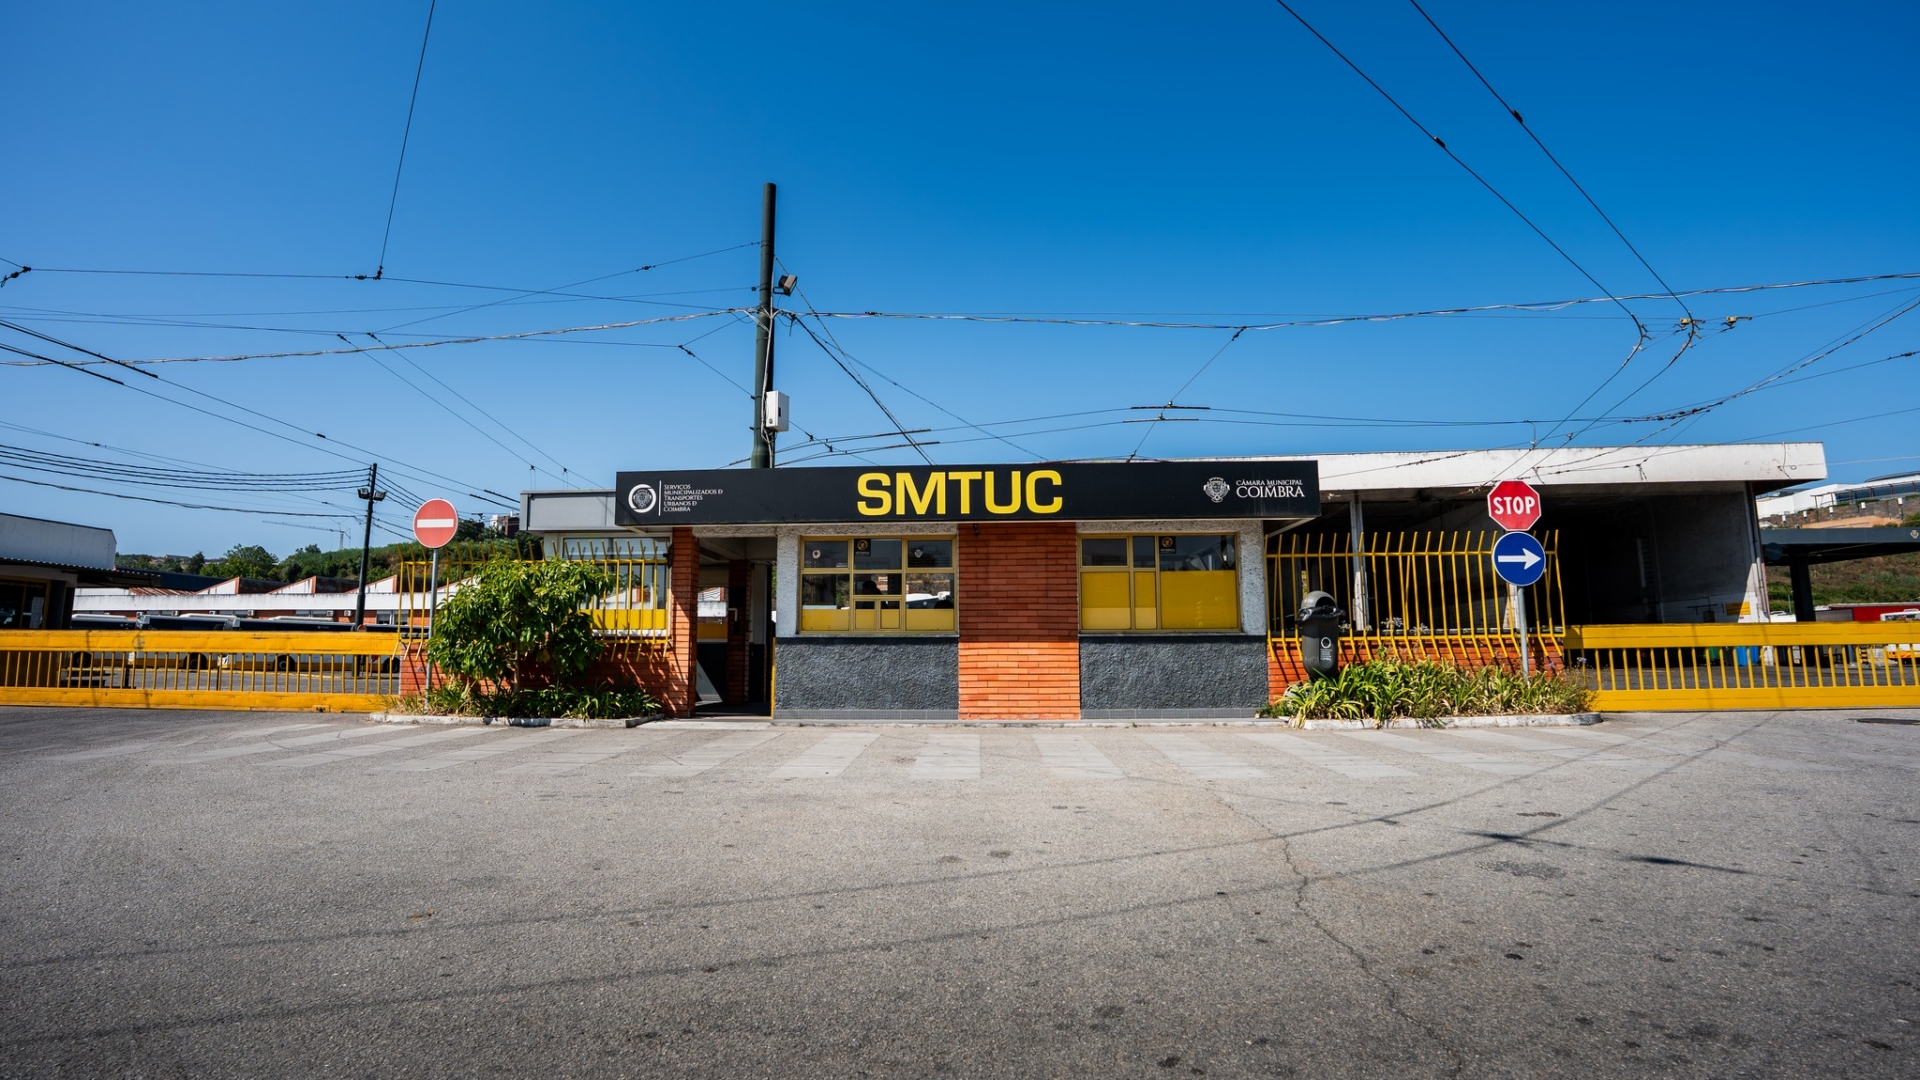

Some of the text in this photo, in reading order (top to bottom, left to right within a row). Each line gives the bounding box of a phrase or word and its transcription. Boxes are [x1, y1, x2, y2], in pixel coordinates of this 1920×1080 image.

[857, 470, 1063, 516] SMTUC
[1236, 485, 1305, 498] COIMBRA
[1493, 496, 1535, 515] STOP
